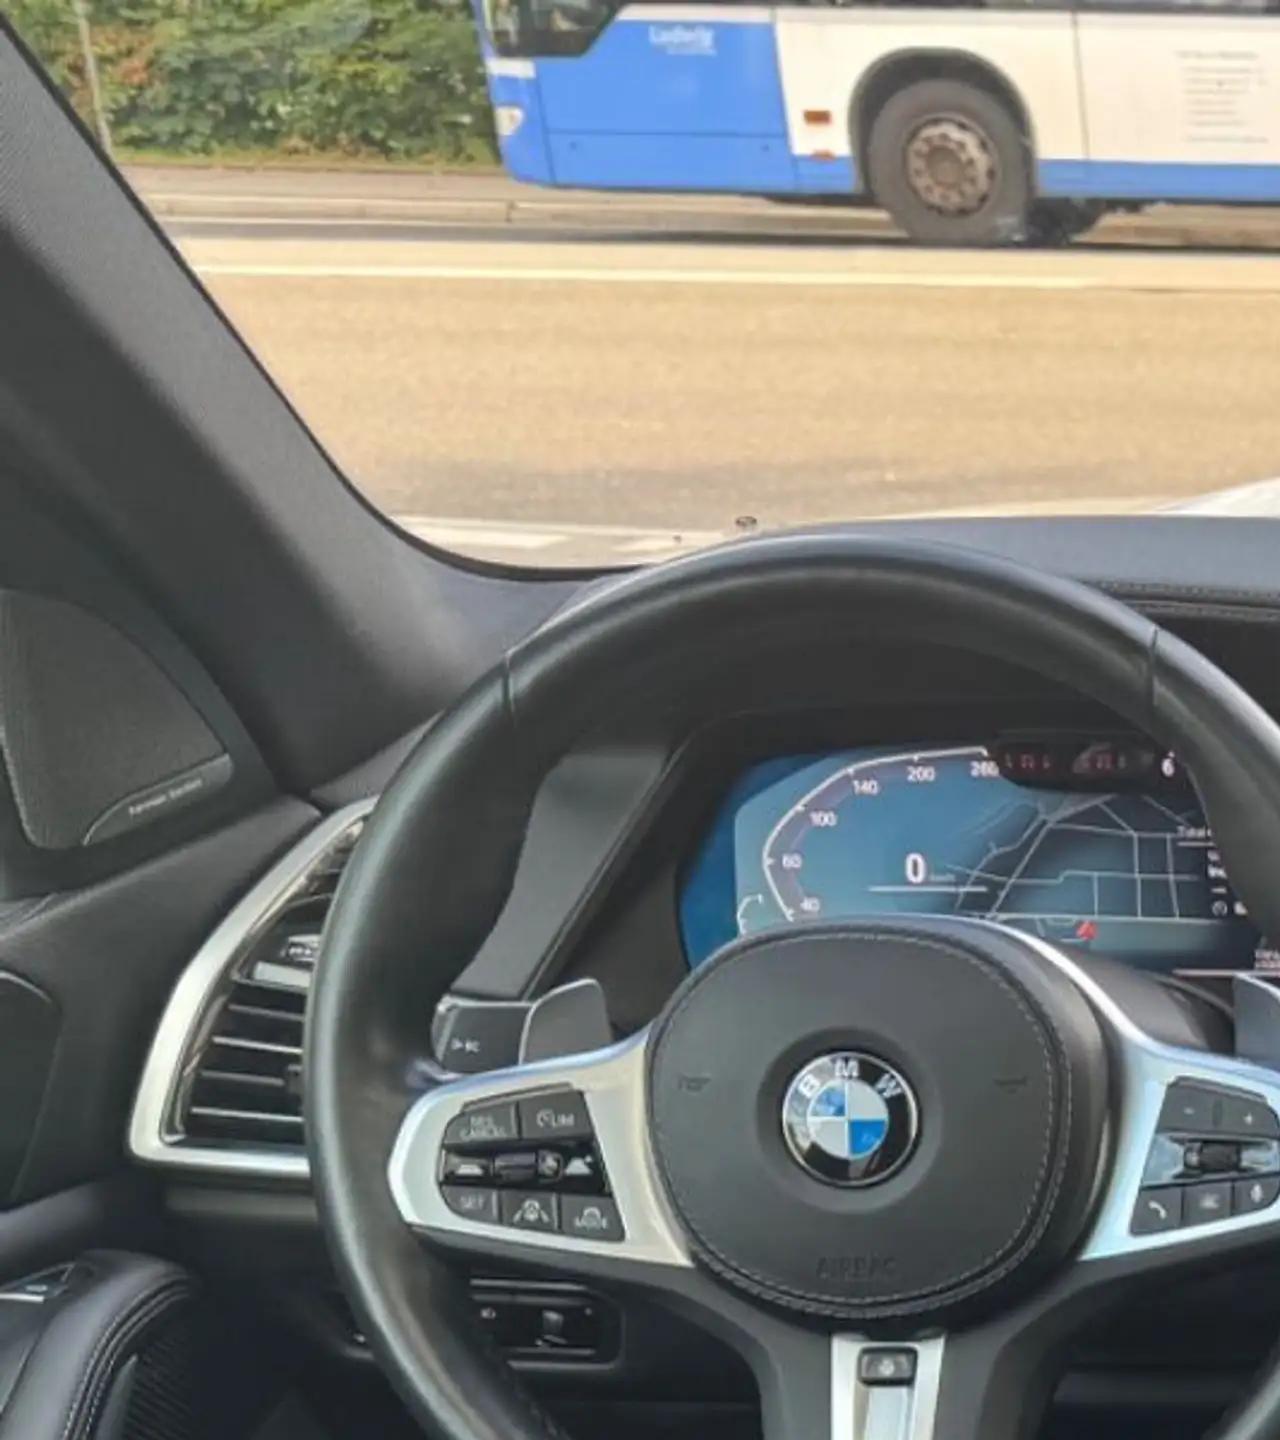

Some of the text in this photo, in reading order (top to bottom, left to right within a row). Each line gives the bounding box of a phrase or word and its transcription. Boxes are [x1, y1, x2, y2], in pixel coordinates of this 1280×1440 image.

[906, 765, 936, 782] 200
[852, 779, 880, 795] 140
[810, 810, 838, 828] 100
[781, 852, 803, 869] 60
[906, 853, 926, 883] 0
[800, 896, 821, 913] 40
[799, 1058, 902, 1098] BMW
